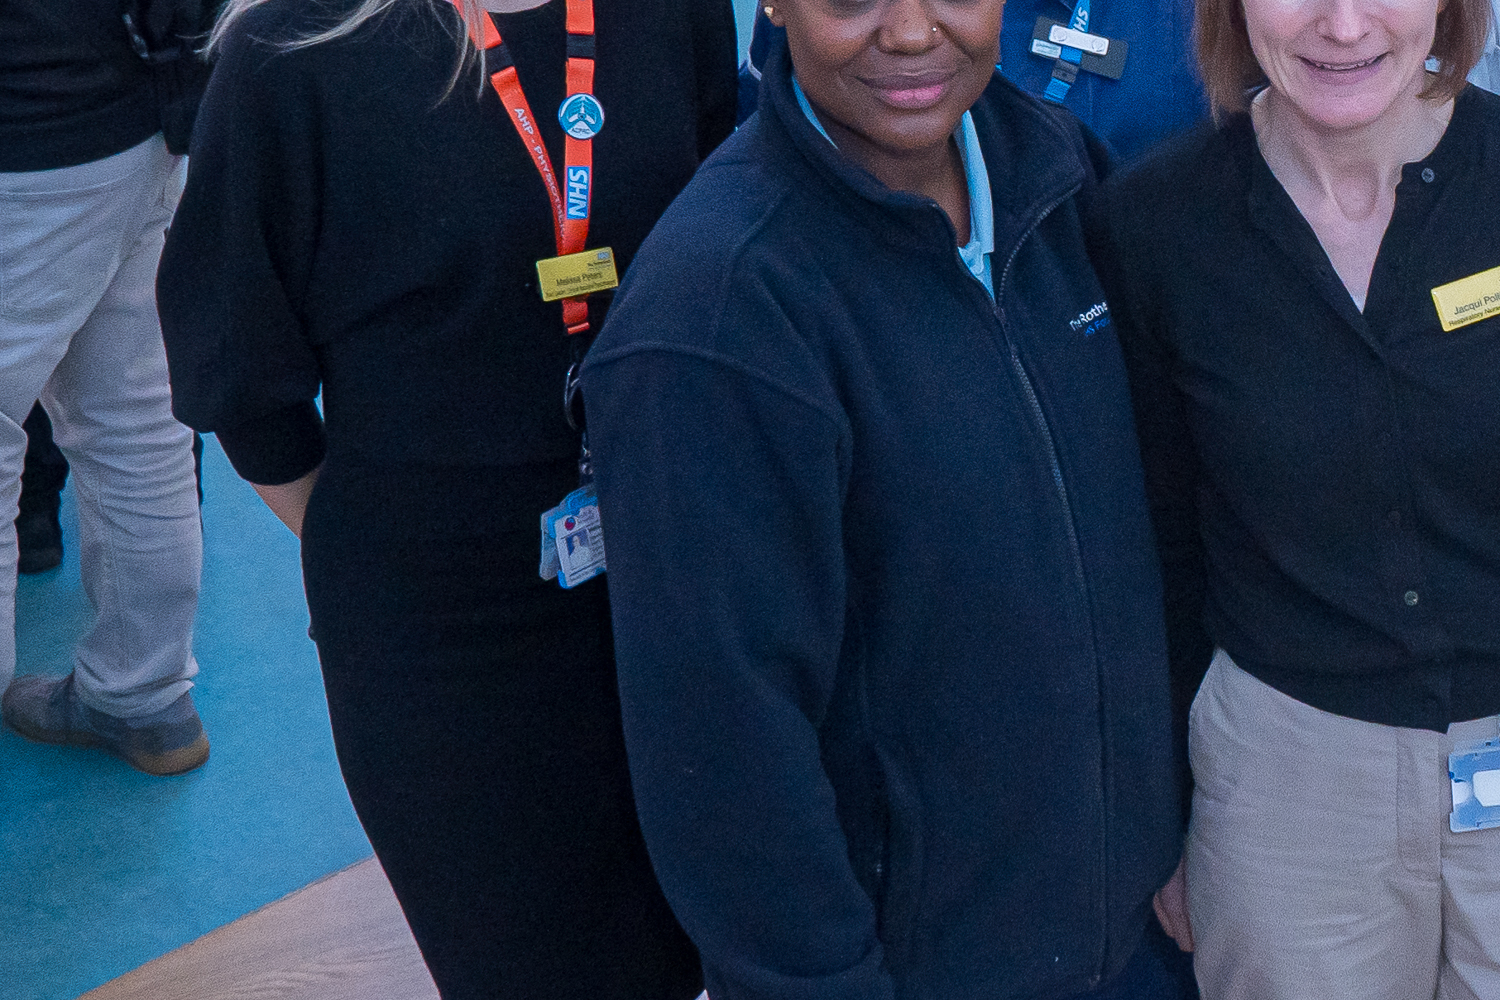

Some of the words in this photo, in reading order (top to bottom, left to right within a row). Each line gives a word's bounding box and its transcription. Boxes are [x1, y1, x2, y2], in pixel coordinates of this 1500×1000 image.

[1073, 6, 1088, 32] HS
[514, 107, 534, 135] AHP
[568, 168, 588, 217] NHS
[1448, 311, 1484, 327] Respiratory
[1454, 300, 1483, 316] Jacqui
